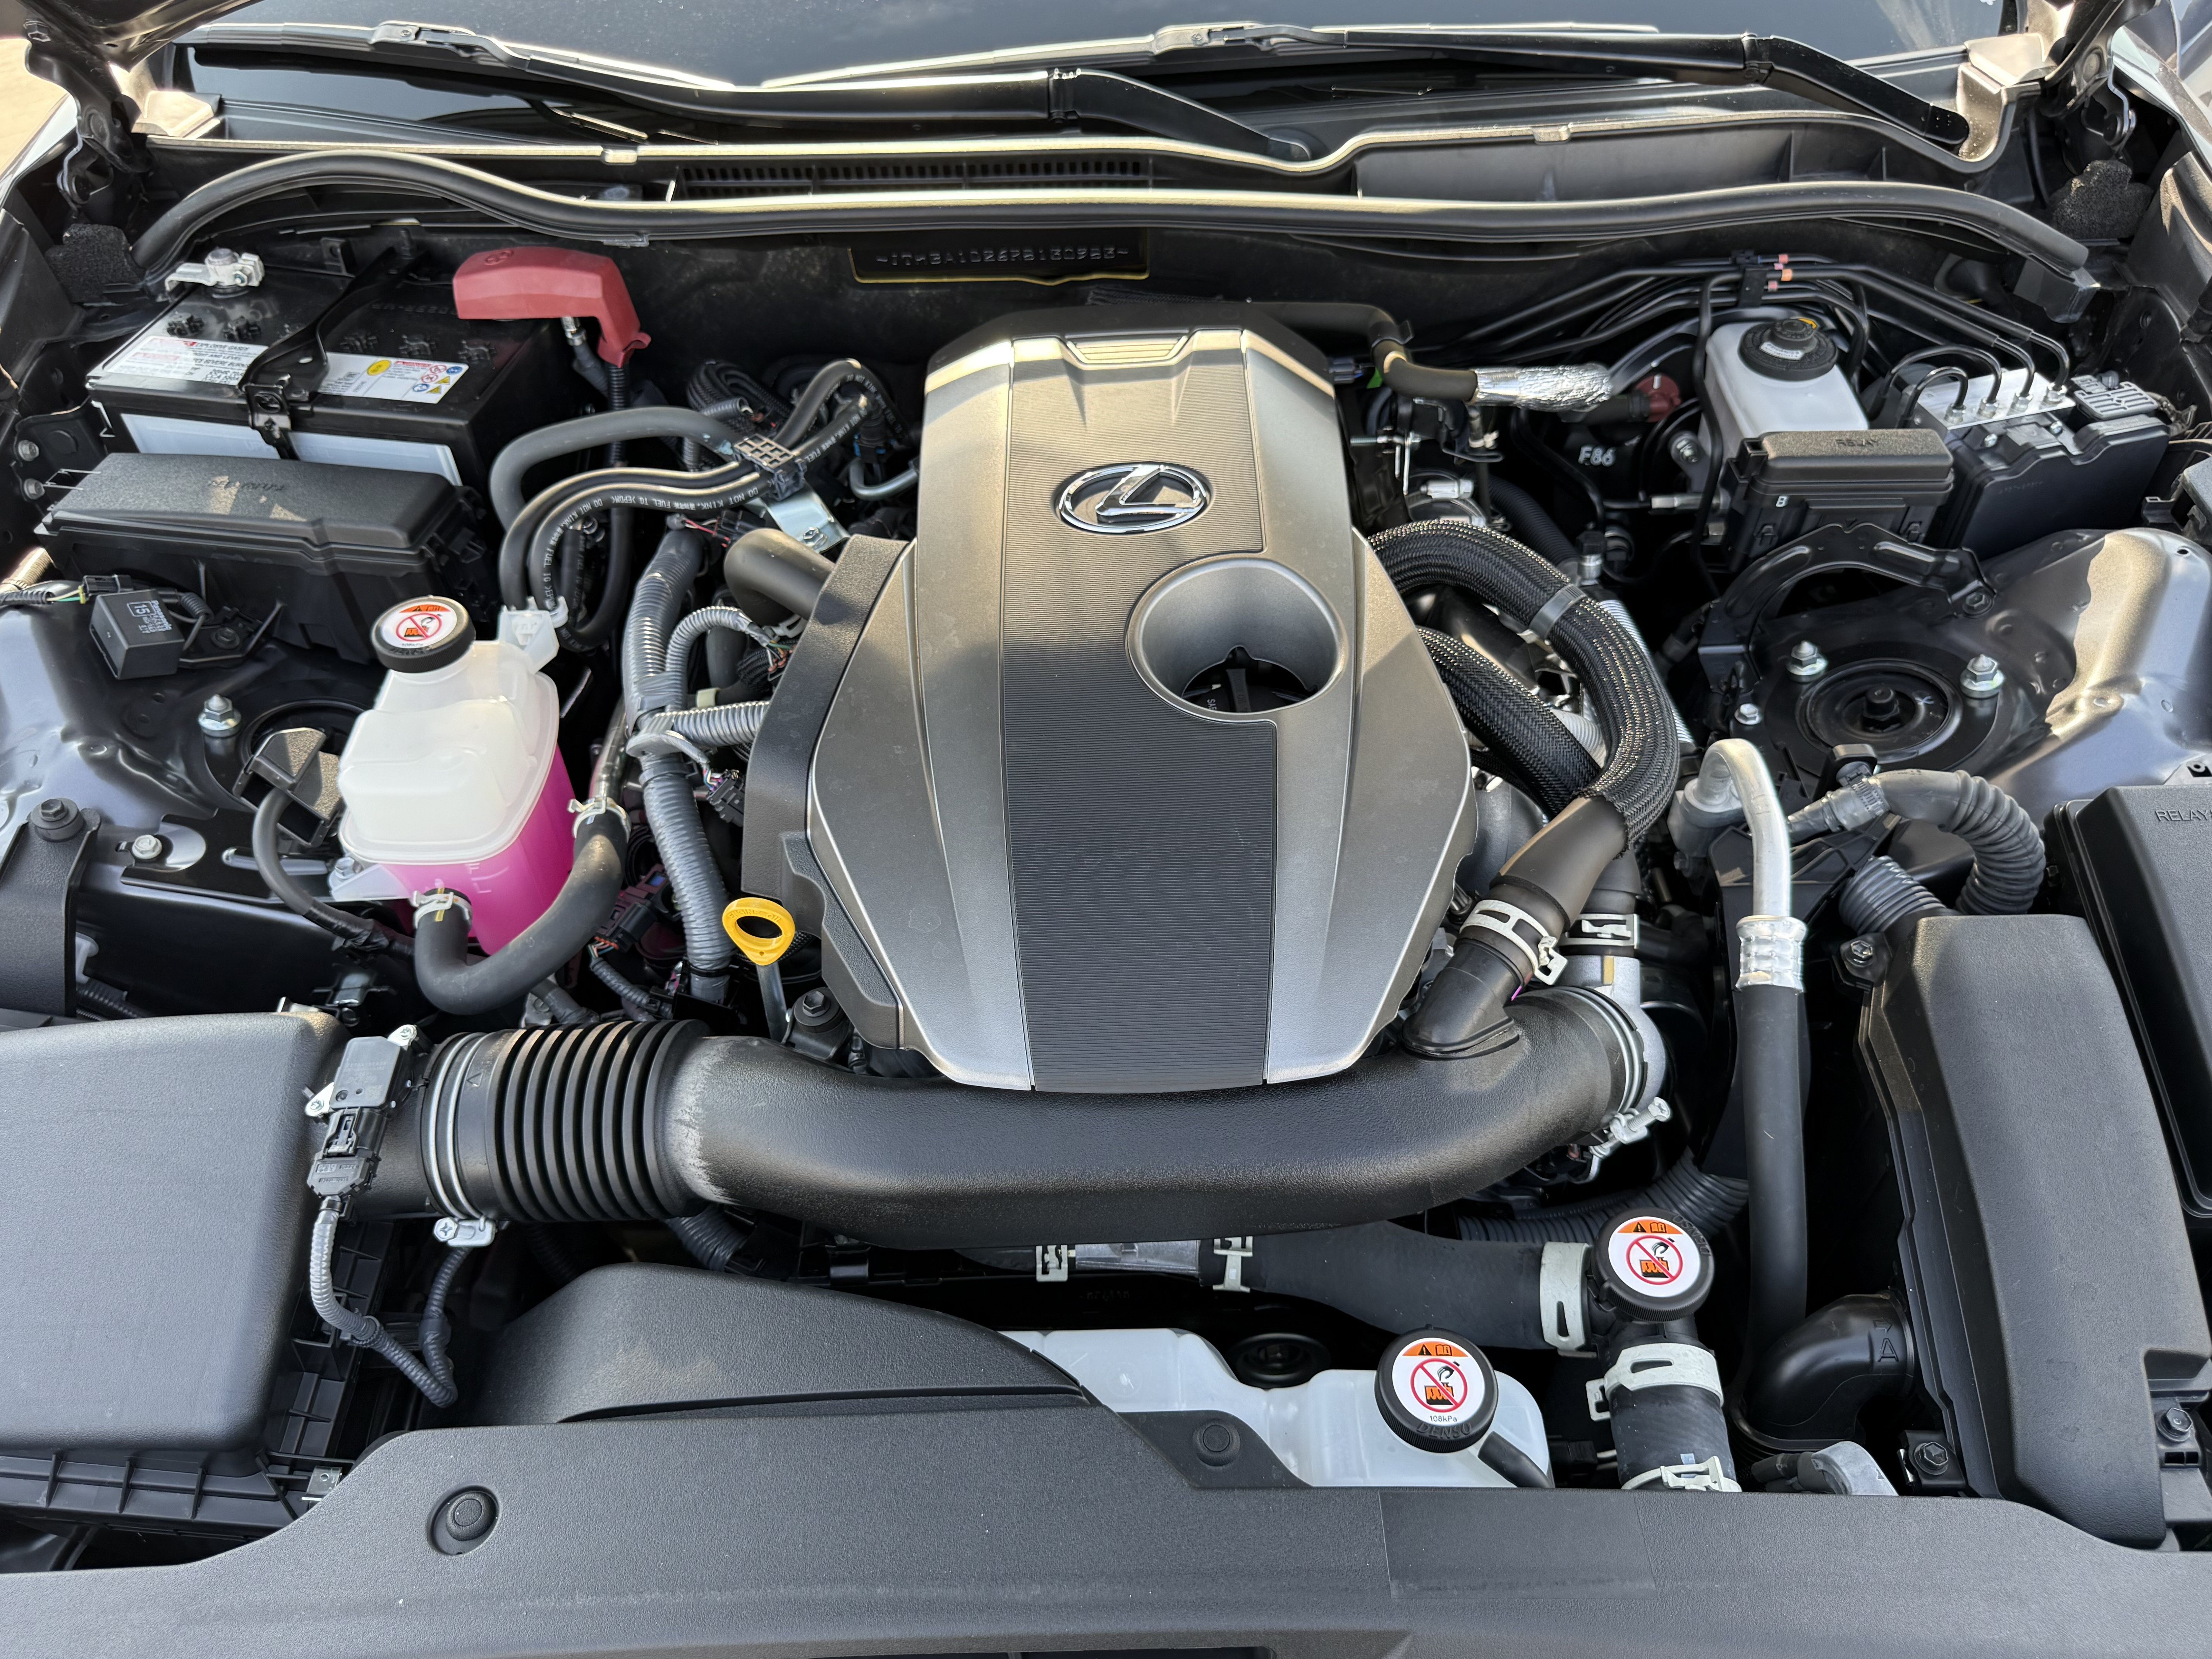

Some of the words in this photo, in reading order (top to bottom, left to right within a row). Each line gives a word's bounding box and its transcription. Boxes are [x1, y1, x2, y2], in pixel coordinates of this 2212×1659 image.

[1578, 445, 1617, 467] F86
[728, 493, 745, 505] NOT
[748, 486, 759, 498] DO
[579, 501, 592, 515] NOT
[593, 498, 603, 508] DO
[651, 497, 671, 508] FUEL
[1775, 496, 1790, 507] B
[543, 547, 555, 568] FUEL
[134, 604, 151, 614] 15
[727, 908, 761, 919] ENGINE
[766, 913, 781, 924] OIL
[1672, 1214, 1712, 1257] DENSO
[1877, 1338, 1899, 1362] A
[1416, 1421, 1472, 1439] DENSO
